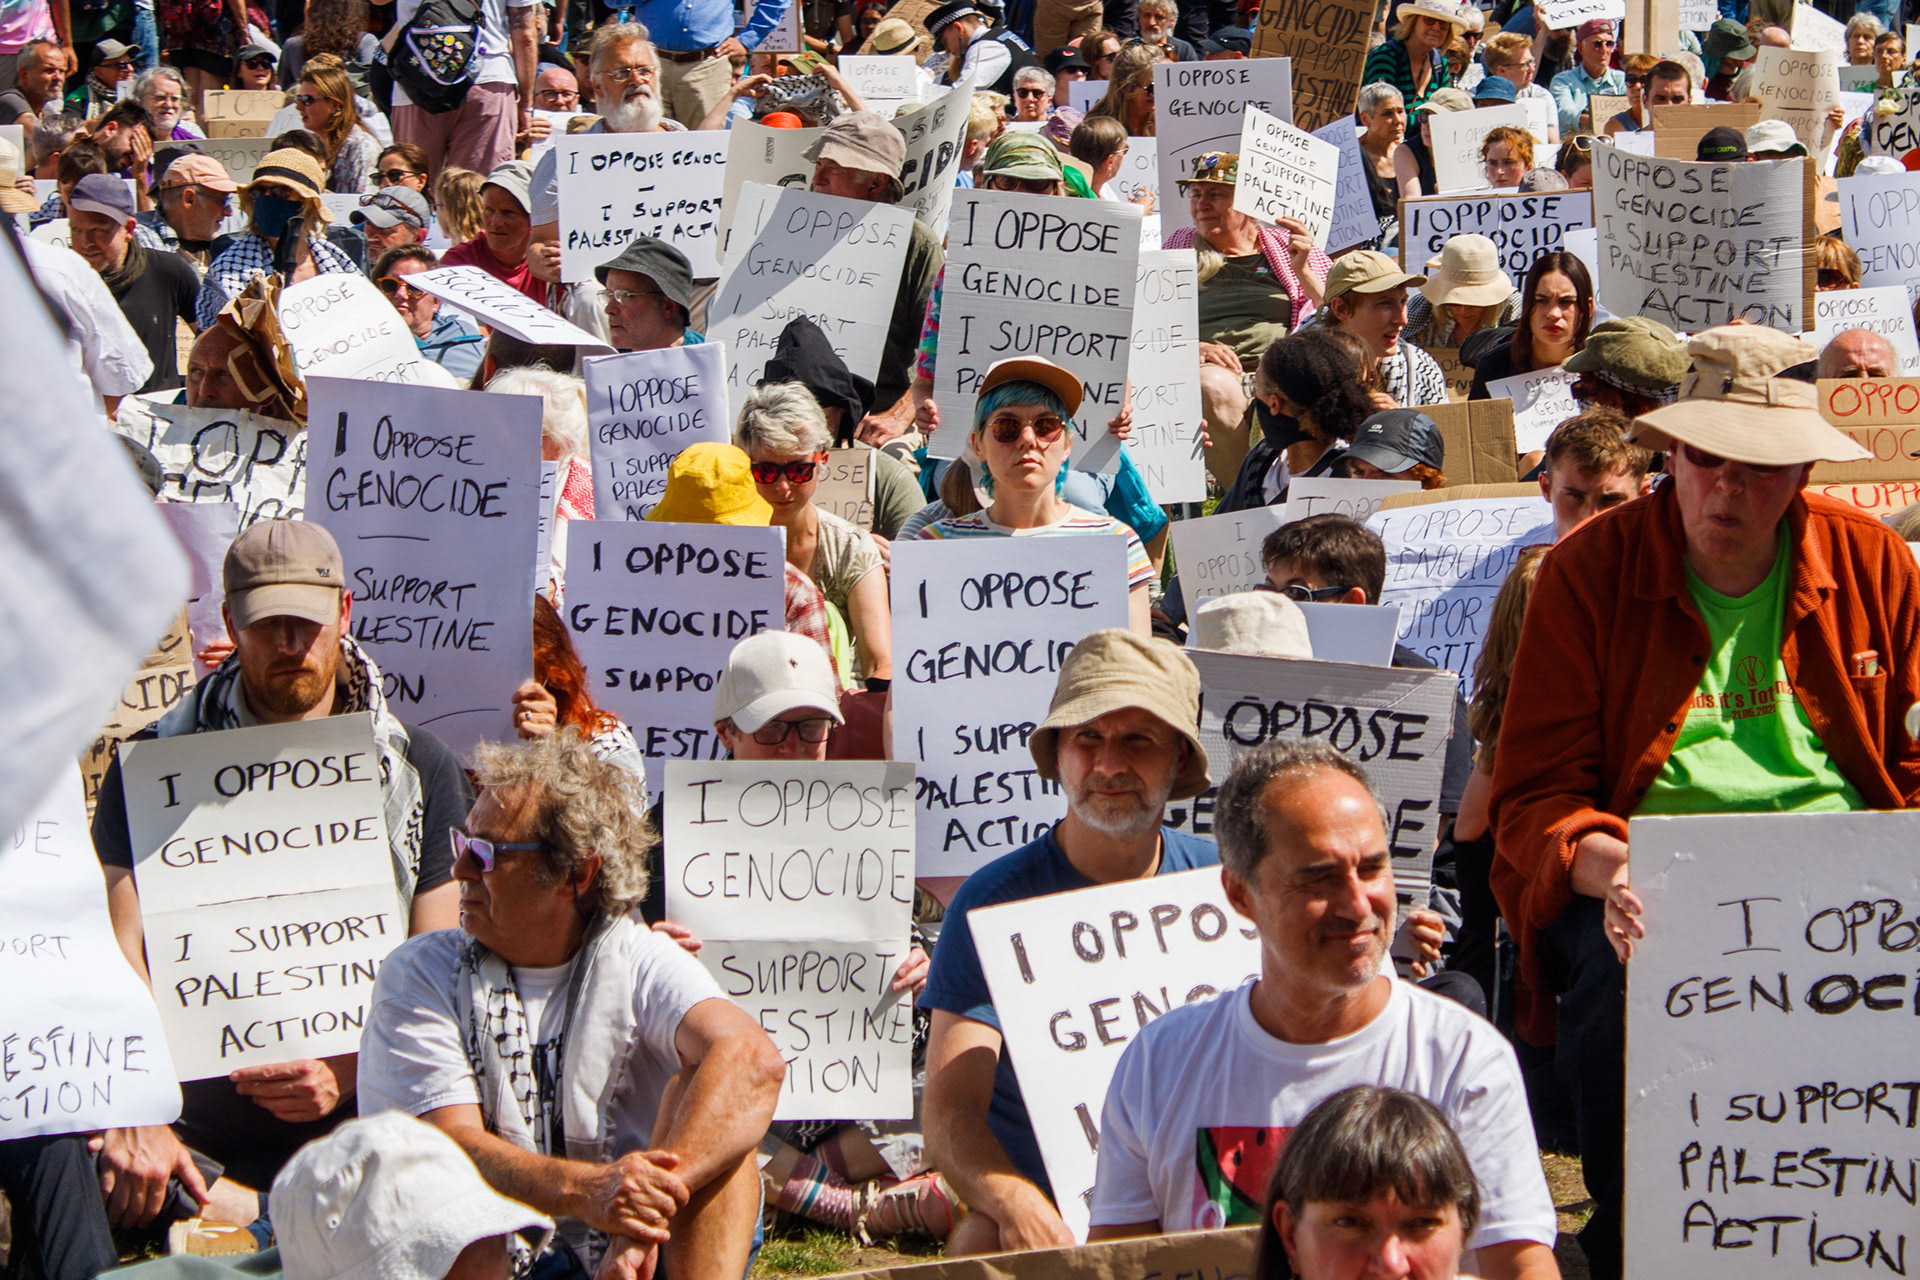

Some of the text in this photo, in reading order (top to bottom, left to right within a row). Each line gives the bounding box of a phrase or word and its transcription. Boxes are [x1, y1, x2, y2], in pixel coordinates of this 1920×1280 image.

[1166, 68, 1250, 87] I OPPOSE
[1779, 59, 1833, 78] OPPOSE
[208, 92, 226, 119] I
[1758, 81, 1833, 103] GENOCIDE
[1252, 116, 1257, 130] I
[1266, 123, 1310, 151] OPPOSE
[1255, 138, 1317, 172] GENOCIDE
[569, 152, 579, 174] I
[591, 151, 664, 172] OPPOSE
[1262, 161, 1317, 190] SUPPORT
[1607, 152, 1730, 194] OPPOSE
[601, 197, 723, 221] I SUPPORT
[1244, 172, 1333, 221] PALESTINE
[1413, 196, 1562, 236] I OPPOSE
[1615, 188, 1766, 228] GENOCIDE
[1851, 194, 1859, 237] I
[755, 199, 905, 248] I OPPOSE
[963, 200, 980, 247] I
[994, 208, 1120, 254] OPPOSE
[1626, 222, 1799, 269] SUPPORT
[747, 242, 881, 288] GENOCIDE
[962, 262, 1120, 307] GENOCIDE
[1610, 245, 1771, 294] PALESTINE
[281, 281, 355, 330] OPPOSE
[1637, 288, 1793, 328] ACTION
[294, 321, 391, 370] GENOCIDE
[958, 315, 975, 355] I
[989, 320, 1128, 361] SUPPORT
[608, 385, 615, 415] I
[620, 374, 699, 412] OPPOSE
[334, 411, 484, 467] I OPPOSE
[599, 408, 706, 445] GENOCIDE
[325, 466, 508, 518] GENOCIDE
[610, 461, 616, 478] I
[1234, 521, 1246, 542] I
[1403, 506, 1531, 543] OPPOSE
[592, 541, 773, 579] I OPPOSE
[351, 567, 477, 613] SUPPORT
[919, 570, 1099, 618] I OPPOSE
[349, 614, 495, 652] LESTINE
[570, 603, 770, 640] GENOCIDE
[605, 666, 723, 693] SUPPO
[918, 726, 925, 761] I
[1222, 695, 1430, 762] OPPOSE
[158, 752, 373, 808] I OPPOSE
[687, 778, 911, 832] I OPPOSE
[160, 815, 379, 868] GENOCIDE
[682, 847, 913, 904] GENOCIDE
[174, 912, 390, 963] I SUPPORT
[1717, 896, 1783, 956] I
[721, 950, 897, 997] SUPPORT
[1009, 931, 1036, 985] I
[174, 958, 384, 1008] PALESTIN
[219, 1004, 365, 1059] ACTION
[1690, 1080, 1920, 1129] I SUPPORT
